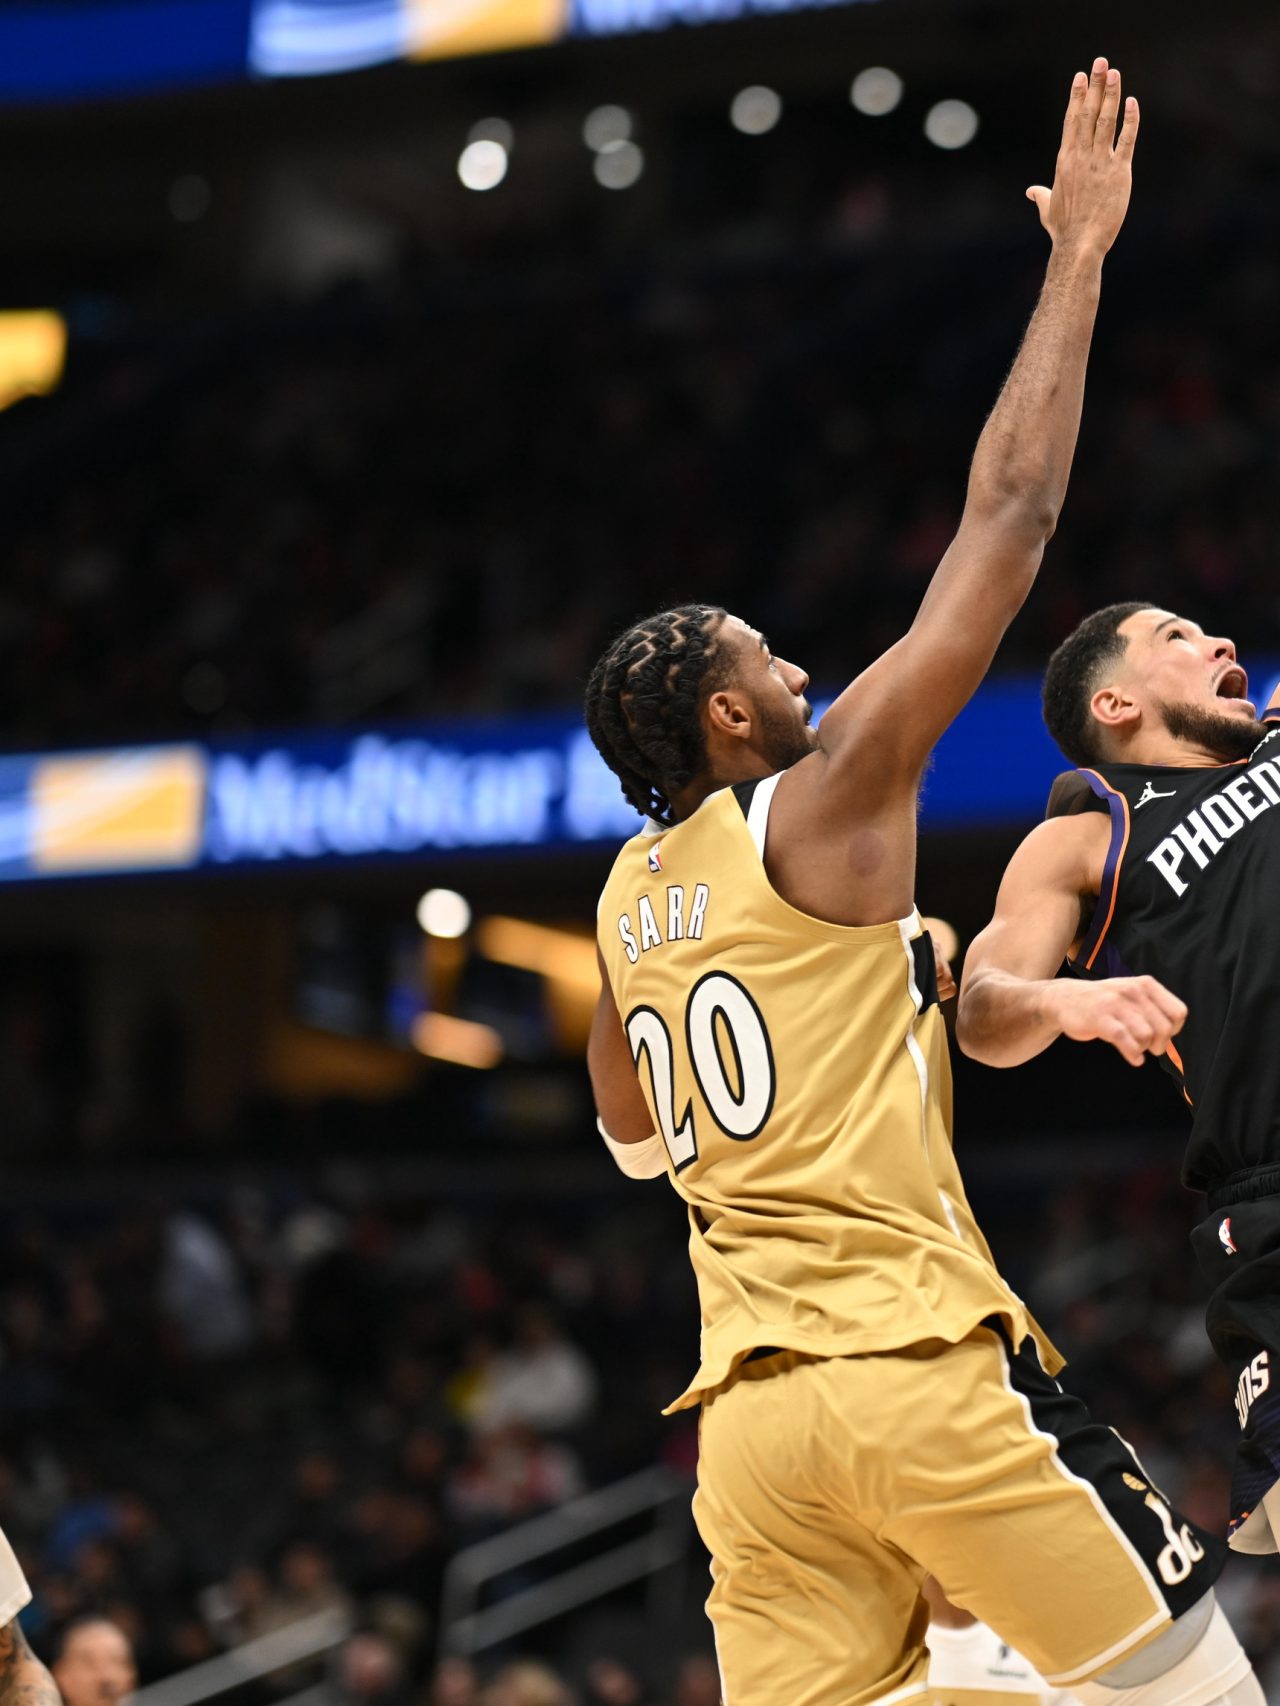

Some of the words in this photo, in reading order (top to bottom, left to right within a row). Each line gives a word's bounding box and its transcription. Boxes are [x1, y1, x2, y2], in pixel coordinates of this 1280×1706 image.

[617, 883, 710, 964] SARR
[624, 969, 776, 1176] 20
[1234, 1349, 1270, 1431] UNS
